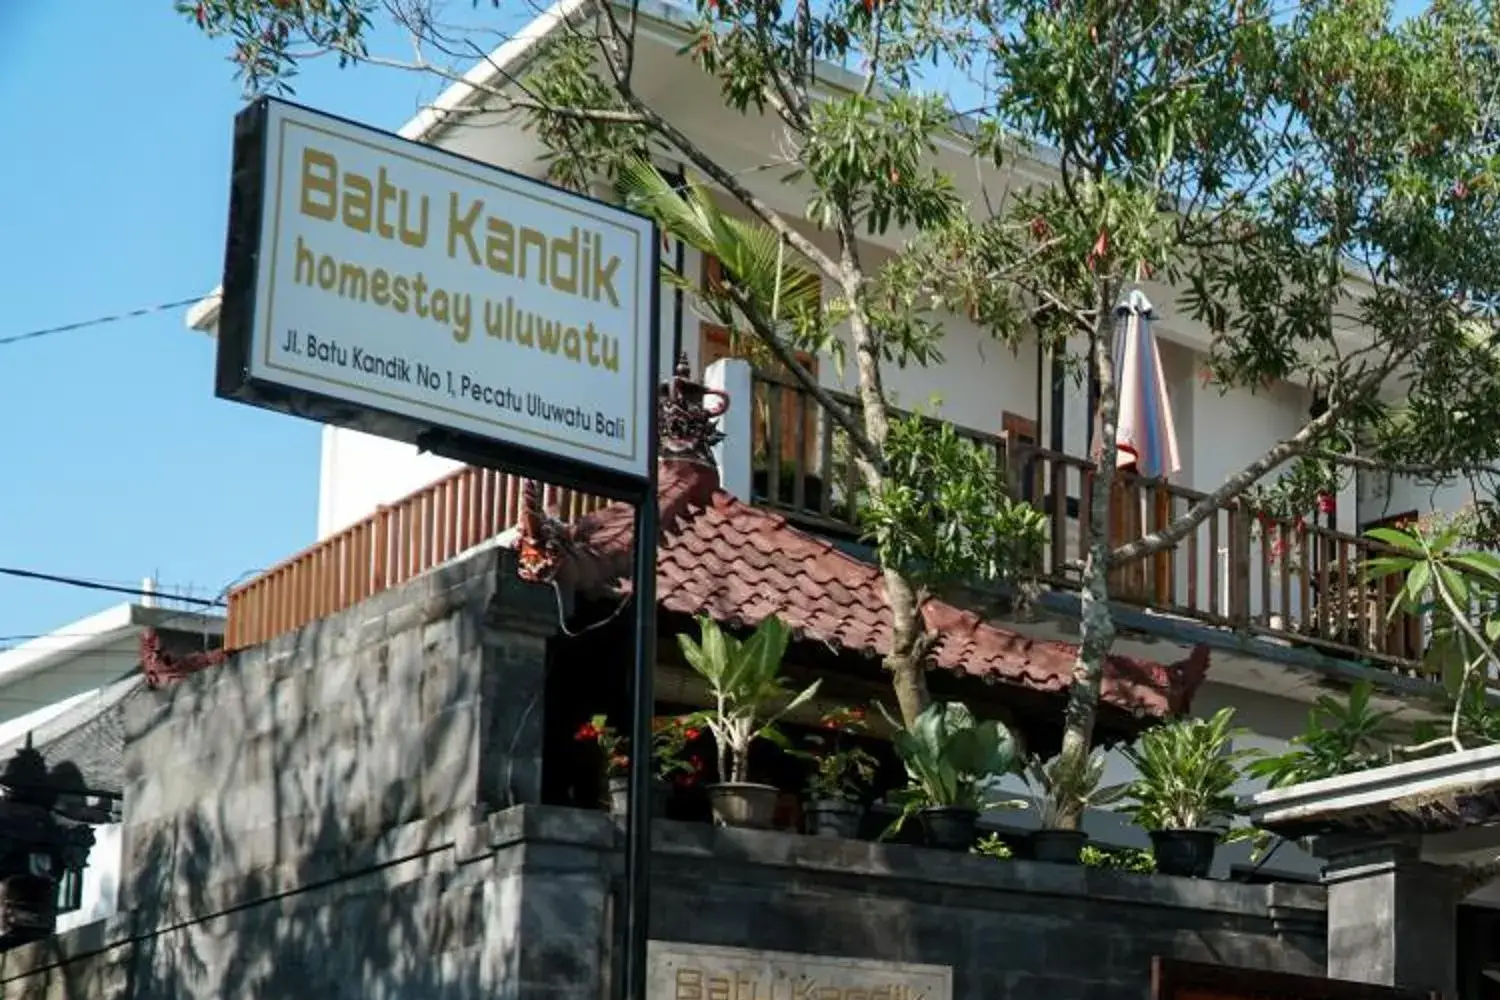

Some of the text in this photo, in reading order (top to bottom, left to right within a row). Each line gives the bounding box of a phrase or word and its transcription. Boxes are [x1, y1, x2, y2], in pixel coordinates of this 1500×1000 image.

[300, 146, 623, 308] Batu Kandik
[294, 236, 619, 372] homestay uluwatu
[282, 329, 301, 355] Jl.
[307, 334, 347, 367] Batu
[352, 345, 411, 384] Kandik
[416, 362, 441, 391] No
[461, 374, 522, 413] Pecatu
[527, 392, 591, 431] Uluwatu
[595, 411, 626, 440] Bali
